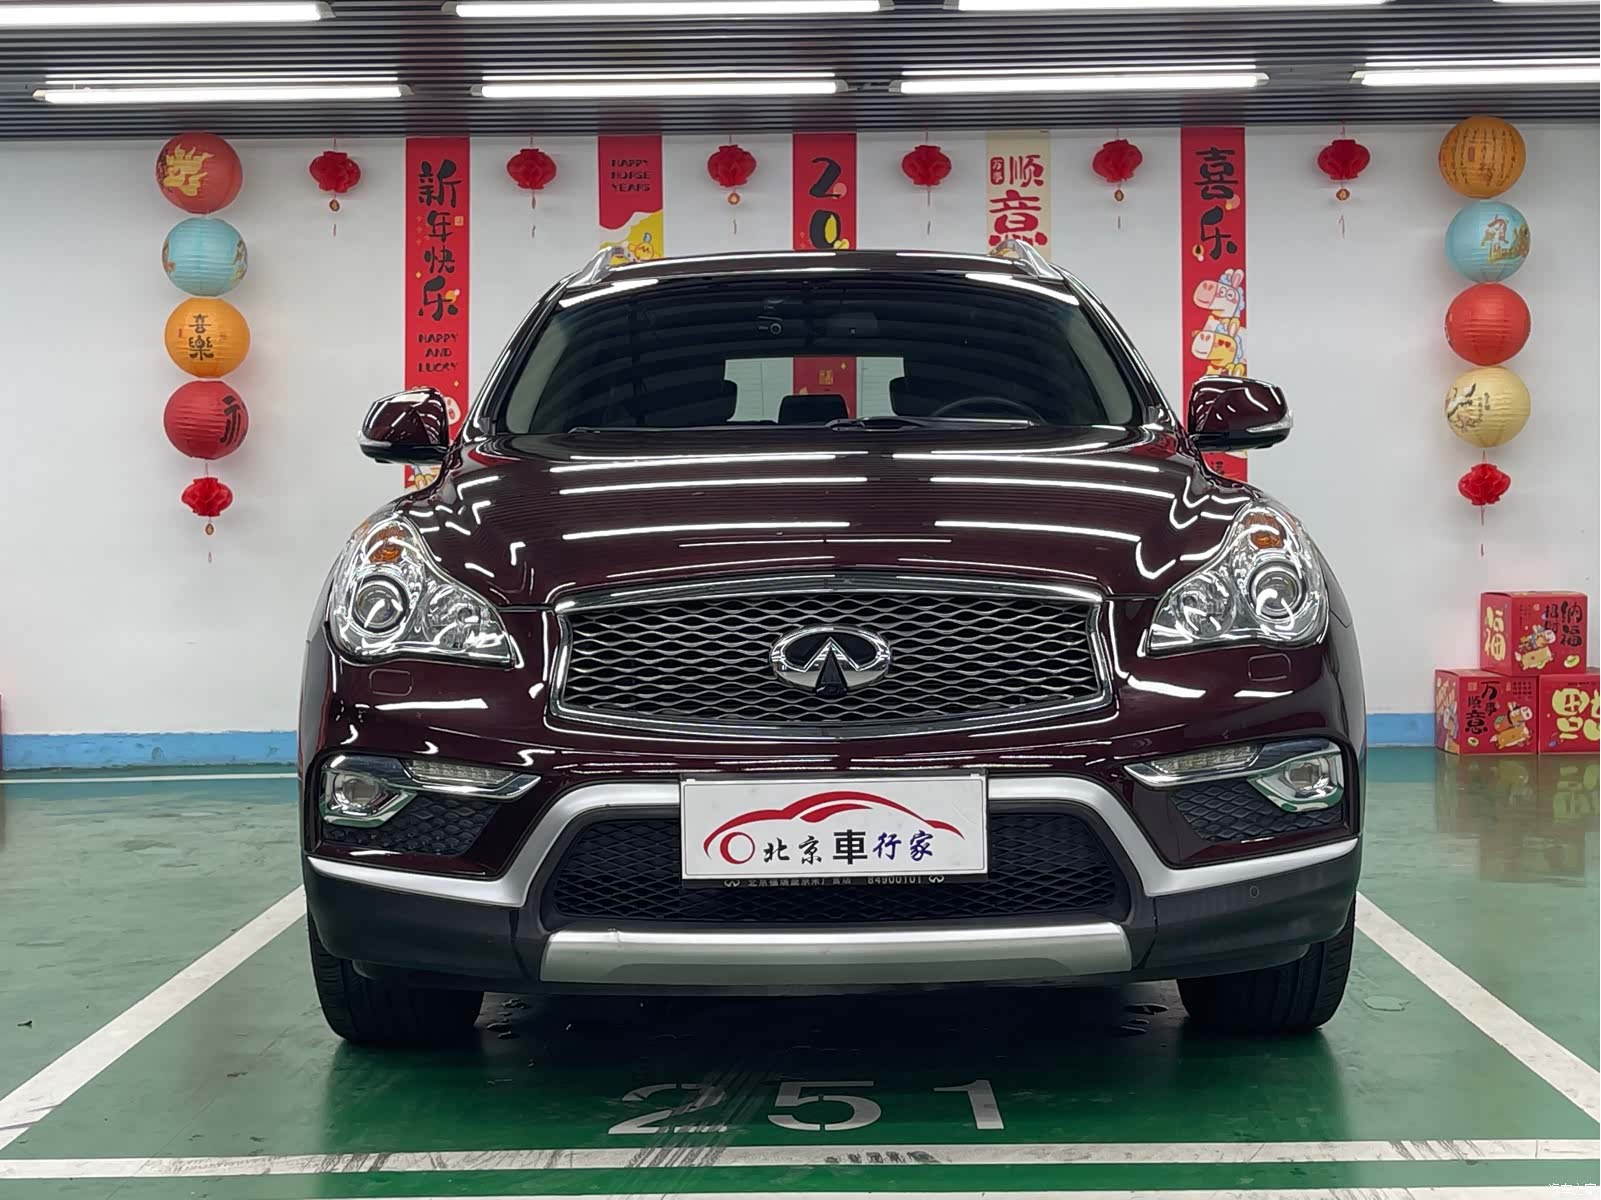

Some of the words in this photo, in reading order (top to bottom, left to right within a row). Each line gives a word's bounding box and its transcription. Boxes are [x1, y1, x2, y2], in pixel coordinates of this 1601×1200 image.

[611, 159, 649, 168] HAPPY
[611, 171, 651, 180] HORSE
[611, 183, 651, 193] YEARS
[988, 154, 1048, 246] 顺意
[809, 156, 842, 250] 20
[1194, 147, 1238, 260] 喜乐
[418, 158, 462, 321] 新年快乐
[418, 333, 459, 343] HAPPY
[425, 347, 453, 358] AND
[418, 362, 458, 373] LUCKY
[763, 829, 935, 866] 北京車行家
[608, 1079, 1005, 1135] 251
